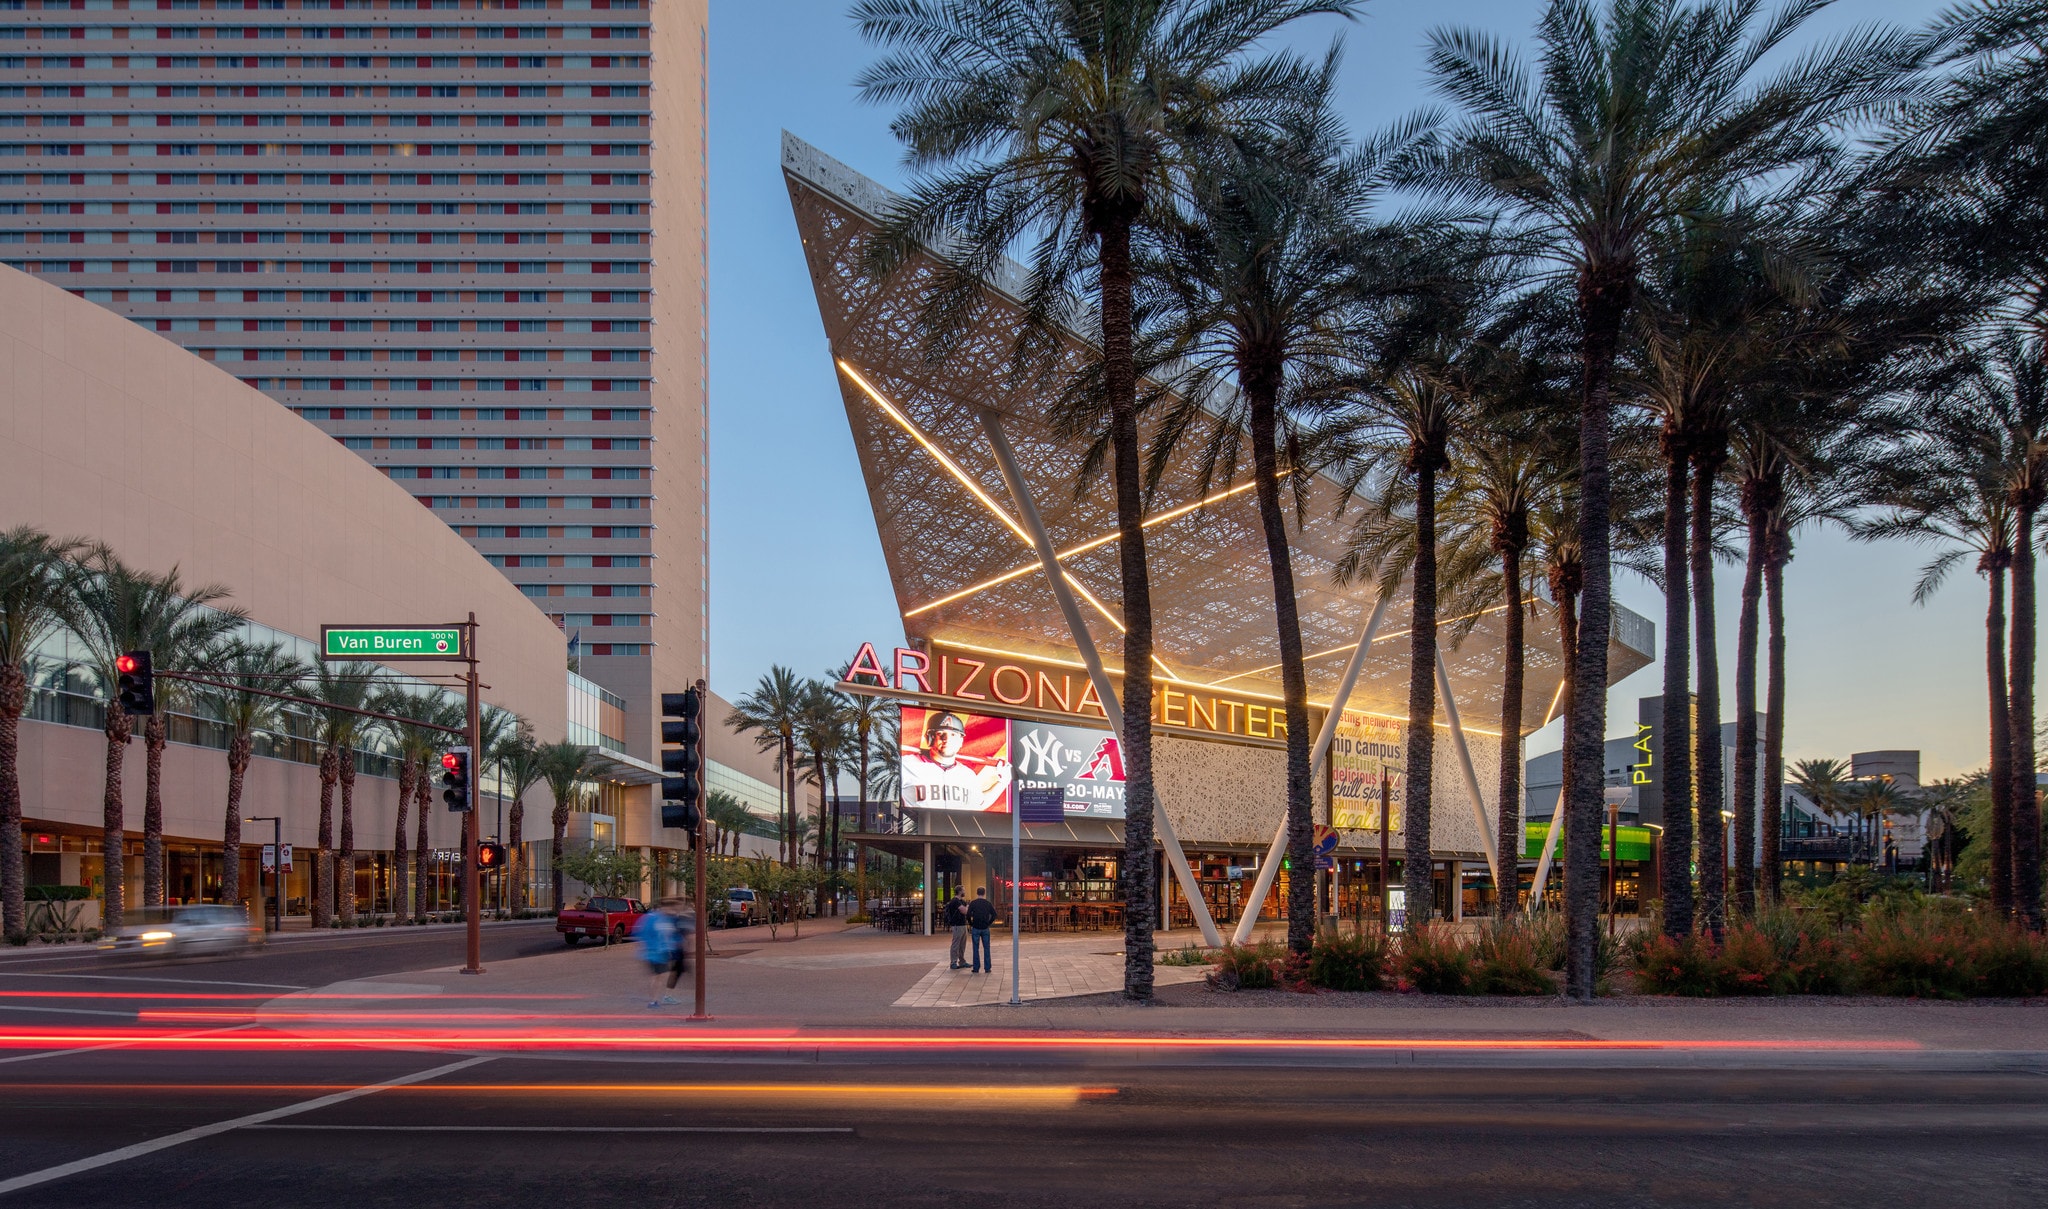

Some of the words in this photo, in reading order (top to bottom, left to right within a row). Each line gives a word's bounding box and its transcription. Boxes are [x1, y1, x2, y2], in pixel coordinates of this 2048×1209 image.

[338, 635, 369, 649] Van
[374, 635, 422, 649] Buren
[430, 632, 446, 640] 300
[447, 632, 454, 640] N
[843, 641, 1108, 717] ARIZONA
[1151, 688, 1288, 741] ENTER
[1339, 710, 1361, 727] sting
[1362, 715, 1401, 730] memories
[1335, 726, 1364, 740] amily
[1064, 748, 1082, 764] VS
[1355, 740, 1401, 761] campus
[1633, 721, 1653, 785] PLAY
[1332, 753, 1378, 774] meeting
[1332, 767, 1377, 785] delicious
[1380, 771, 1401, 787] fod
[1066, 783, 1125, 800] 30-MAY
[1332, 776, 1363, 798] chill
[1362, 785, 1401, 807] spaes
[1063, 802, 1085, 810] ks.com
[1333, 803, 1371, 828] local
[1376, 802, 1401, 815] vws
